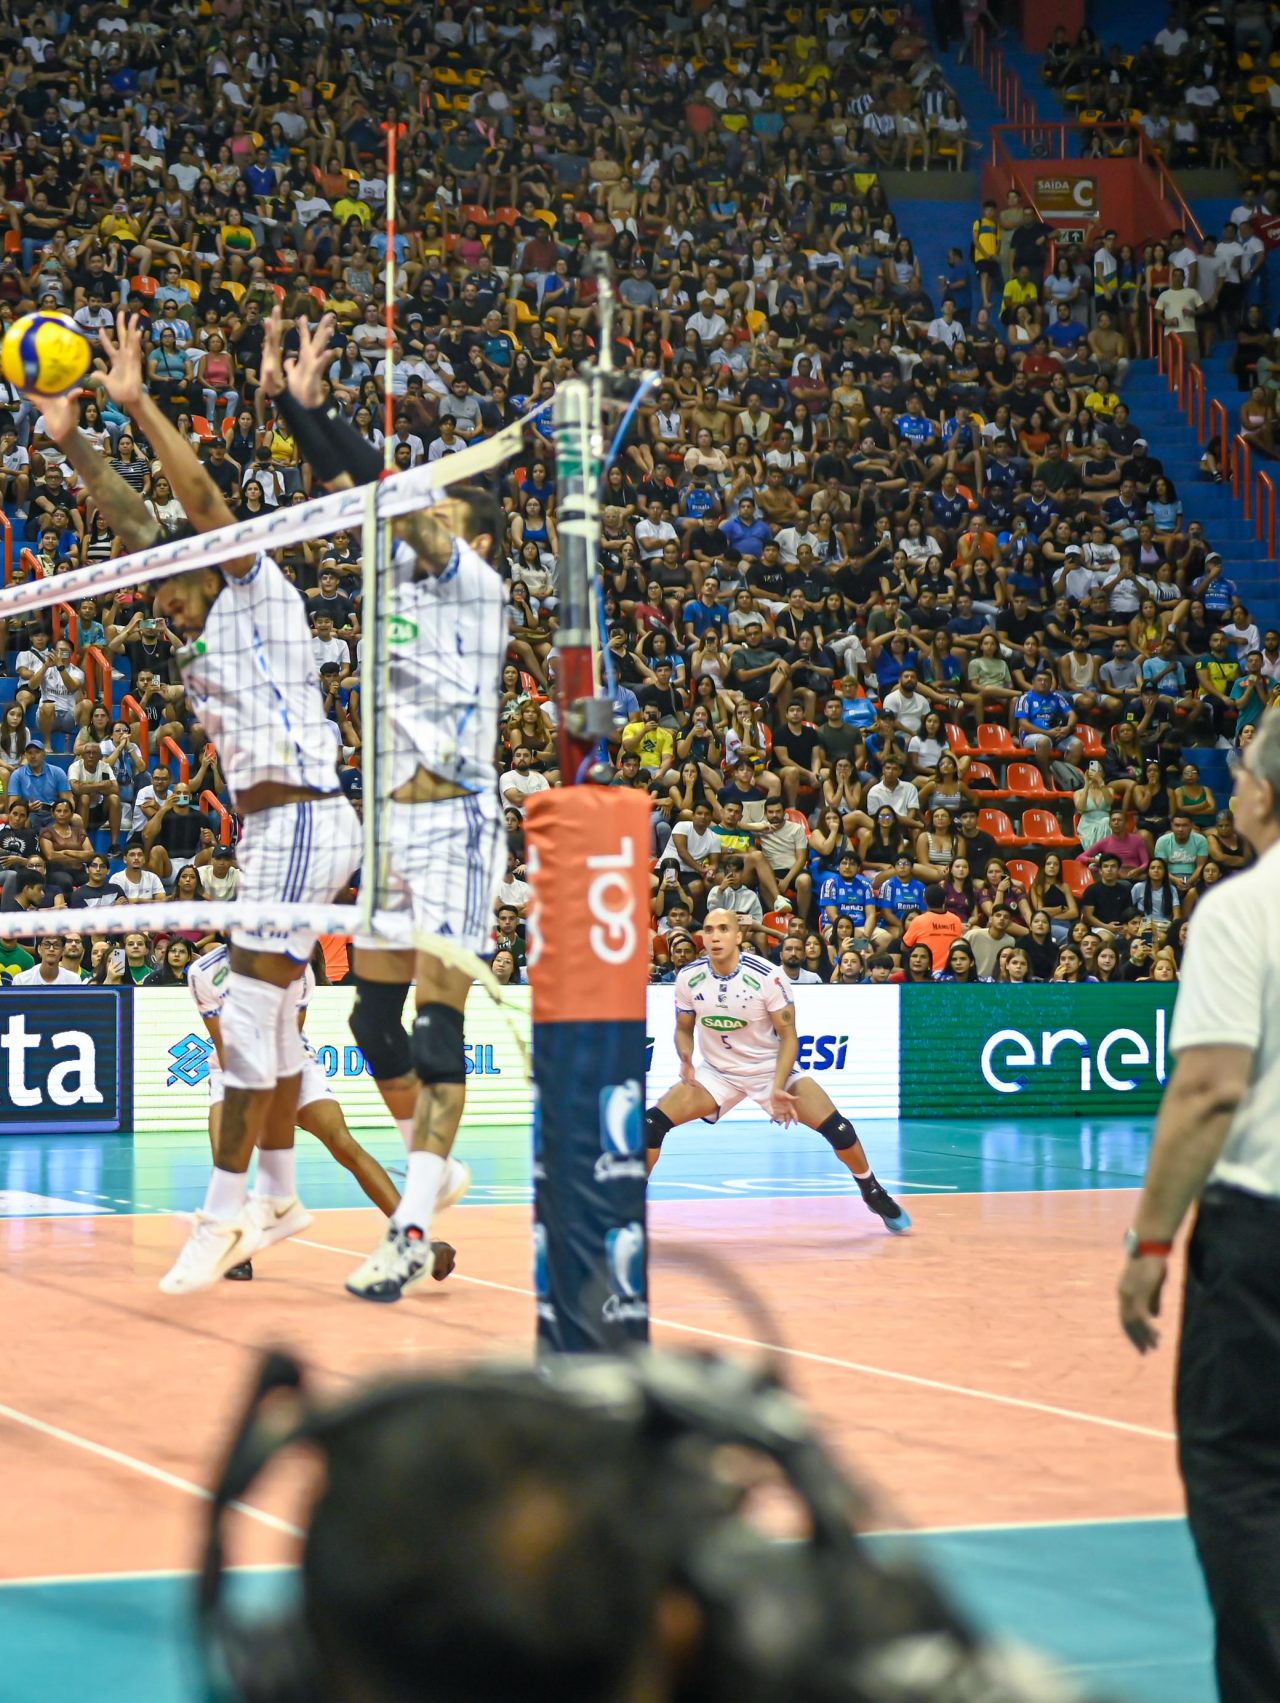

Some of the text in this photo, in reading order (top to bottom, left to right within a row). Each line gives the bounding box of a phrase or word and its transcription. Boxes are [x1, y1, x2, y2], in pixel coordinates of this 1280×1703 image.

[1073, 180, 1094, 207] C
[586, 836, 637, 965] GOL
[704, 1018, 744, 1029] SADA
[720, 1035, 733, 1050] 5
[981, 1009, 1165, 1092] enel
[464, 1045, 500, 1076] SIL
